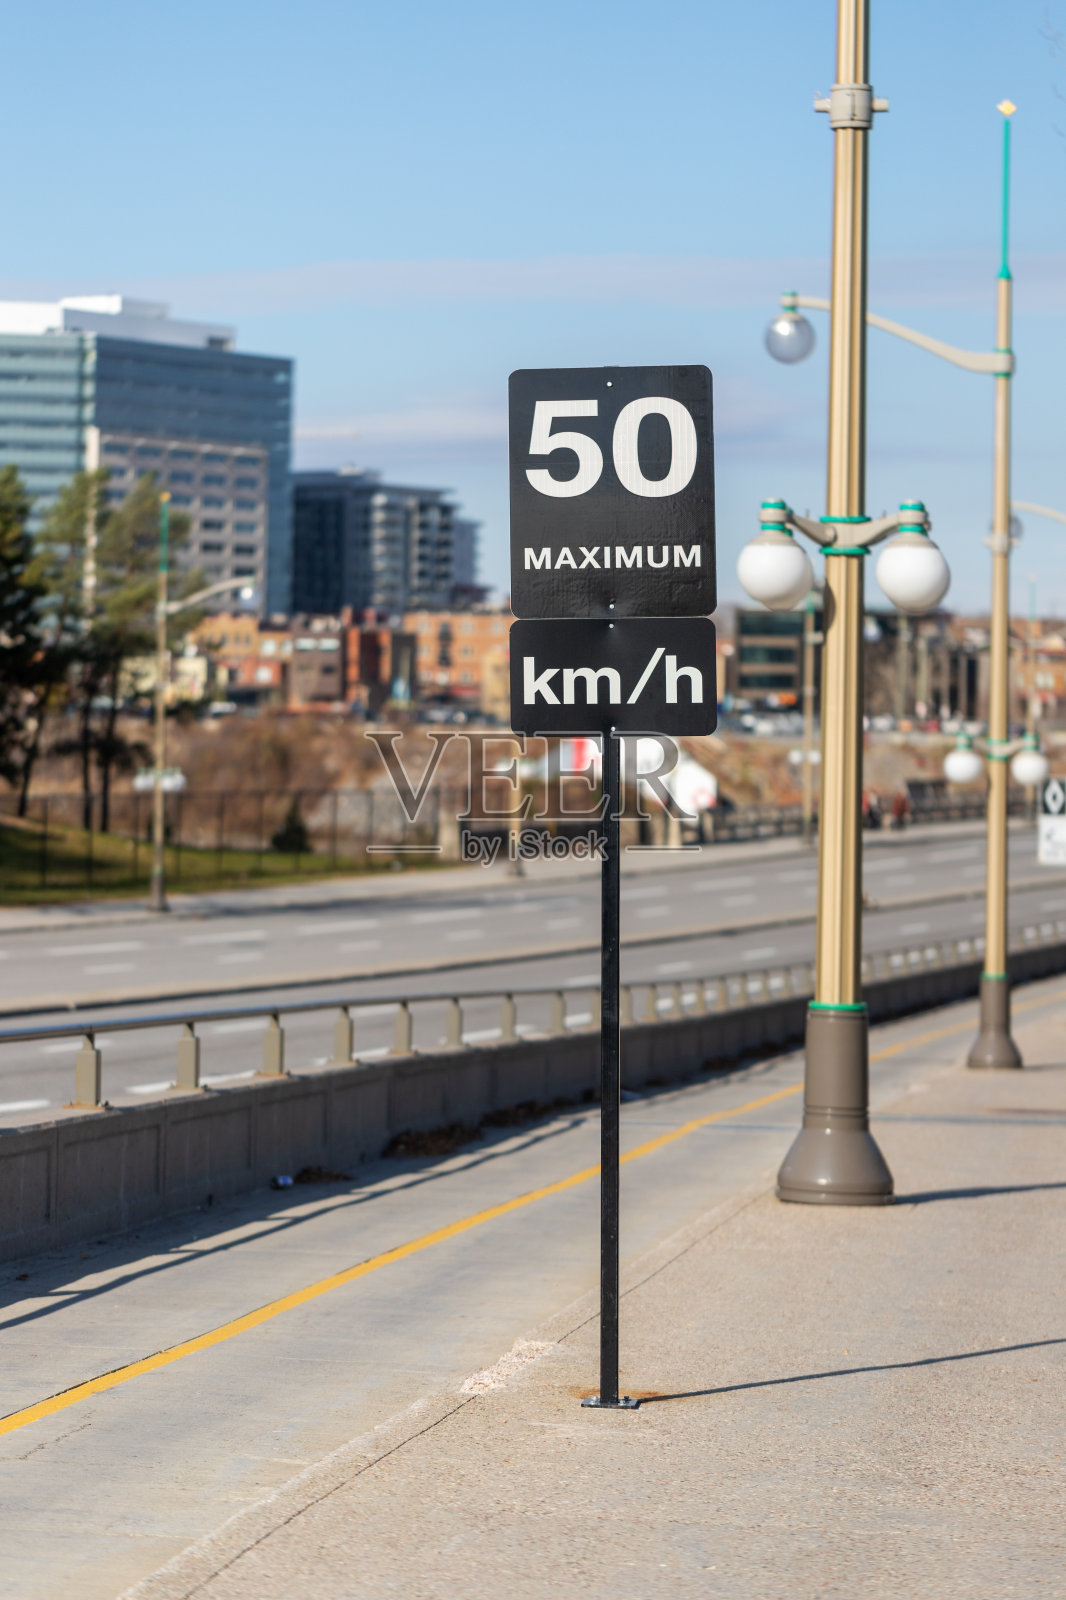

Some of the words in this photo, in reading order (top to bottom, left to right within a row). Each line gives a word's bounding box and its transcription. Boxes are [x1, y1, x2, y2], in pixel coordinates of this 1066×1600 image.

[525, 396, 698, 498] 50
[523, 545, 701, 570] MAXIMUM
[523, 647, 703, 705] km/h
